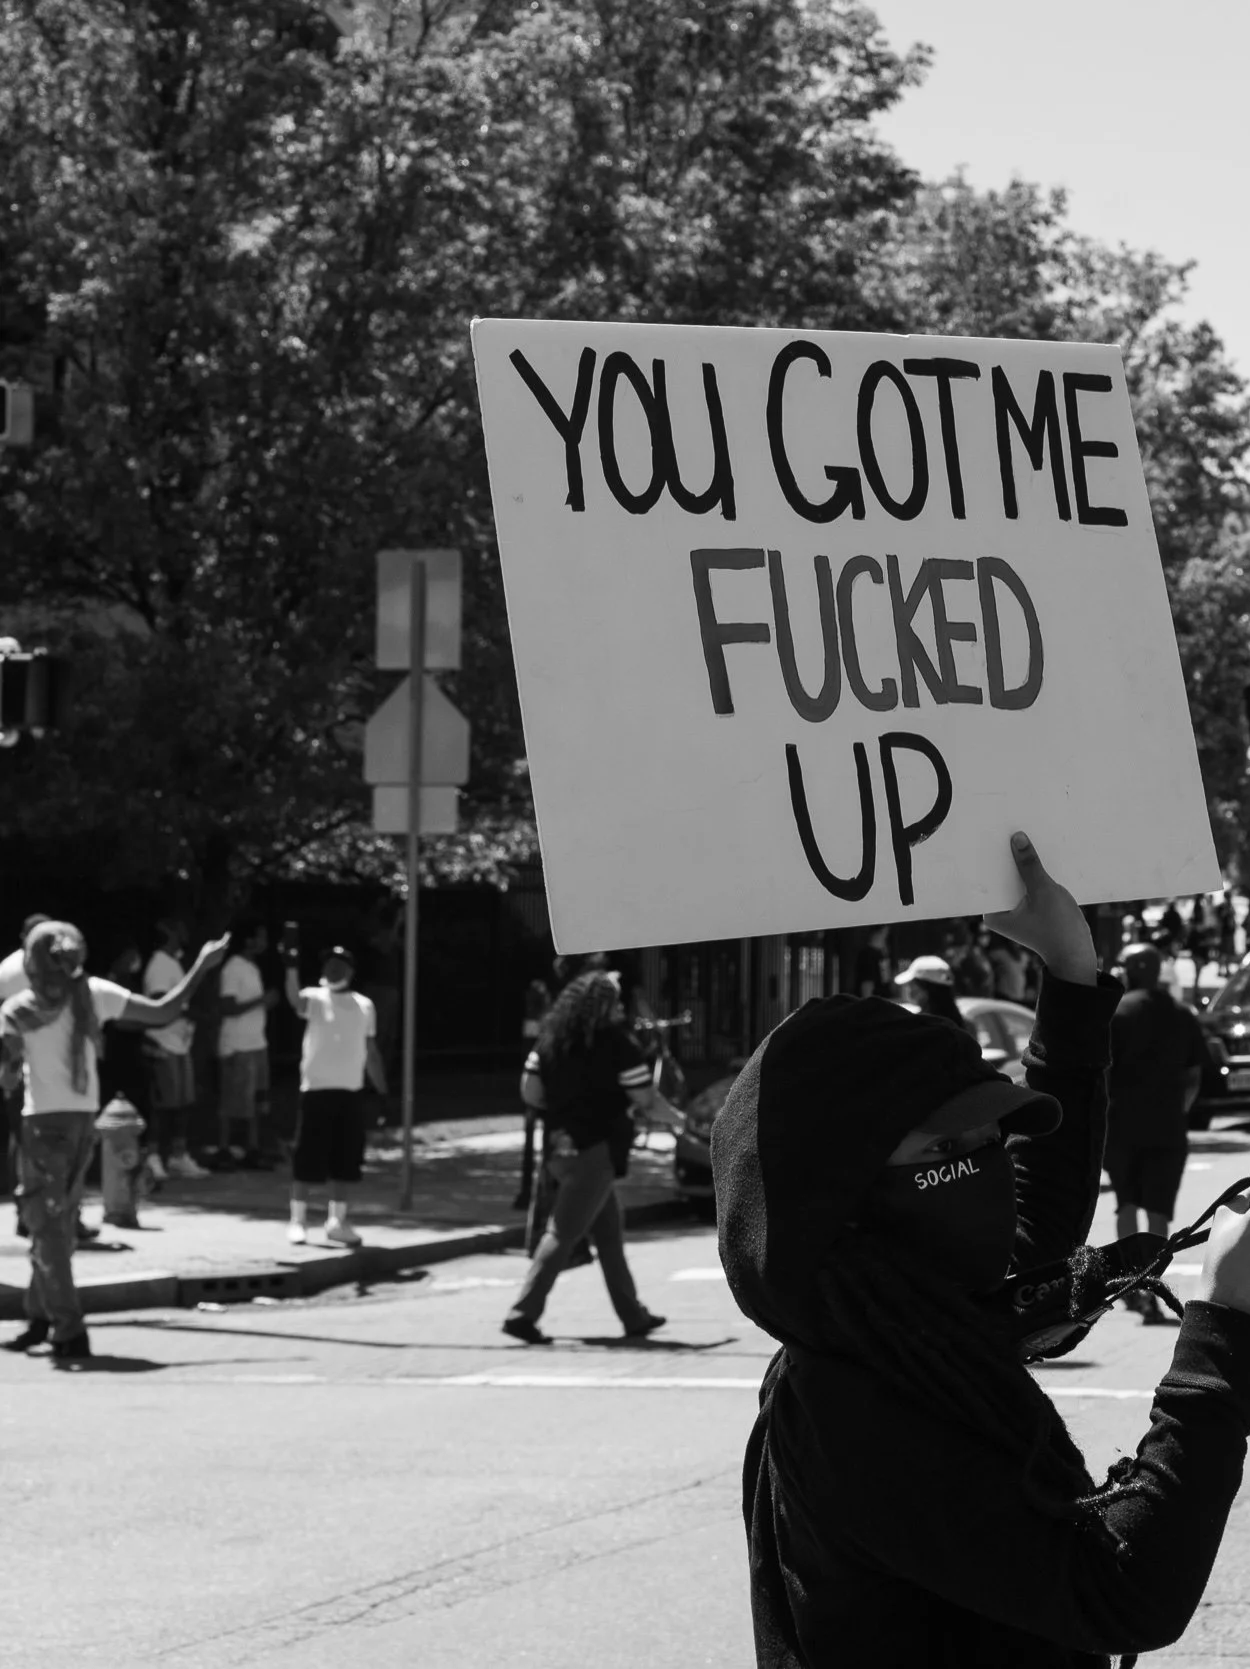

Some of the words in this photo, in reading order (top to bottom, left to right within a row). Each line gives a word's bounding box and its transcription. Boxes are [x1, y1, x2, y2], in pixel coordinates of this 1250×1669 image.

[509, 346, 736, 521] YOU
[766, 340, 980, 524] GOT
[992, 364, 1128, 527] ME
[690, 547, 1044, 723] FUCKED
[785, 731, 953, 906] UP
[914, 1157, 981, 1191] SOCIAL
[1014, 1276, 1067, 1306] Can
